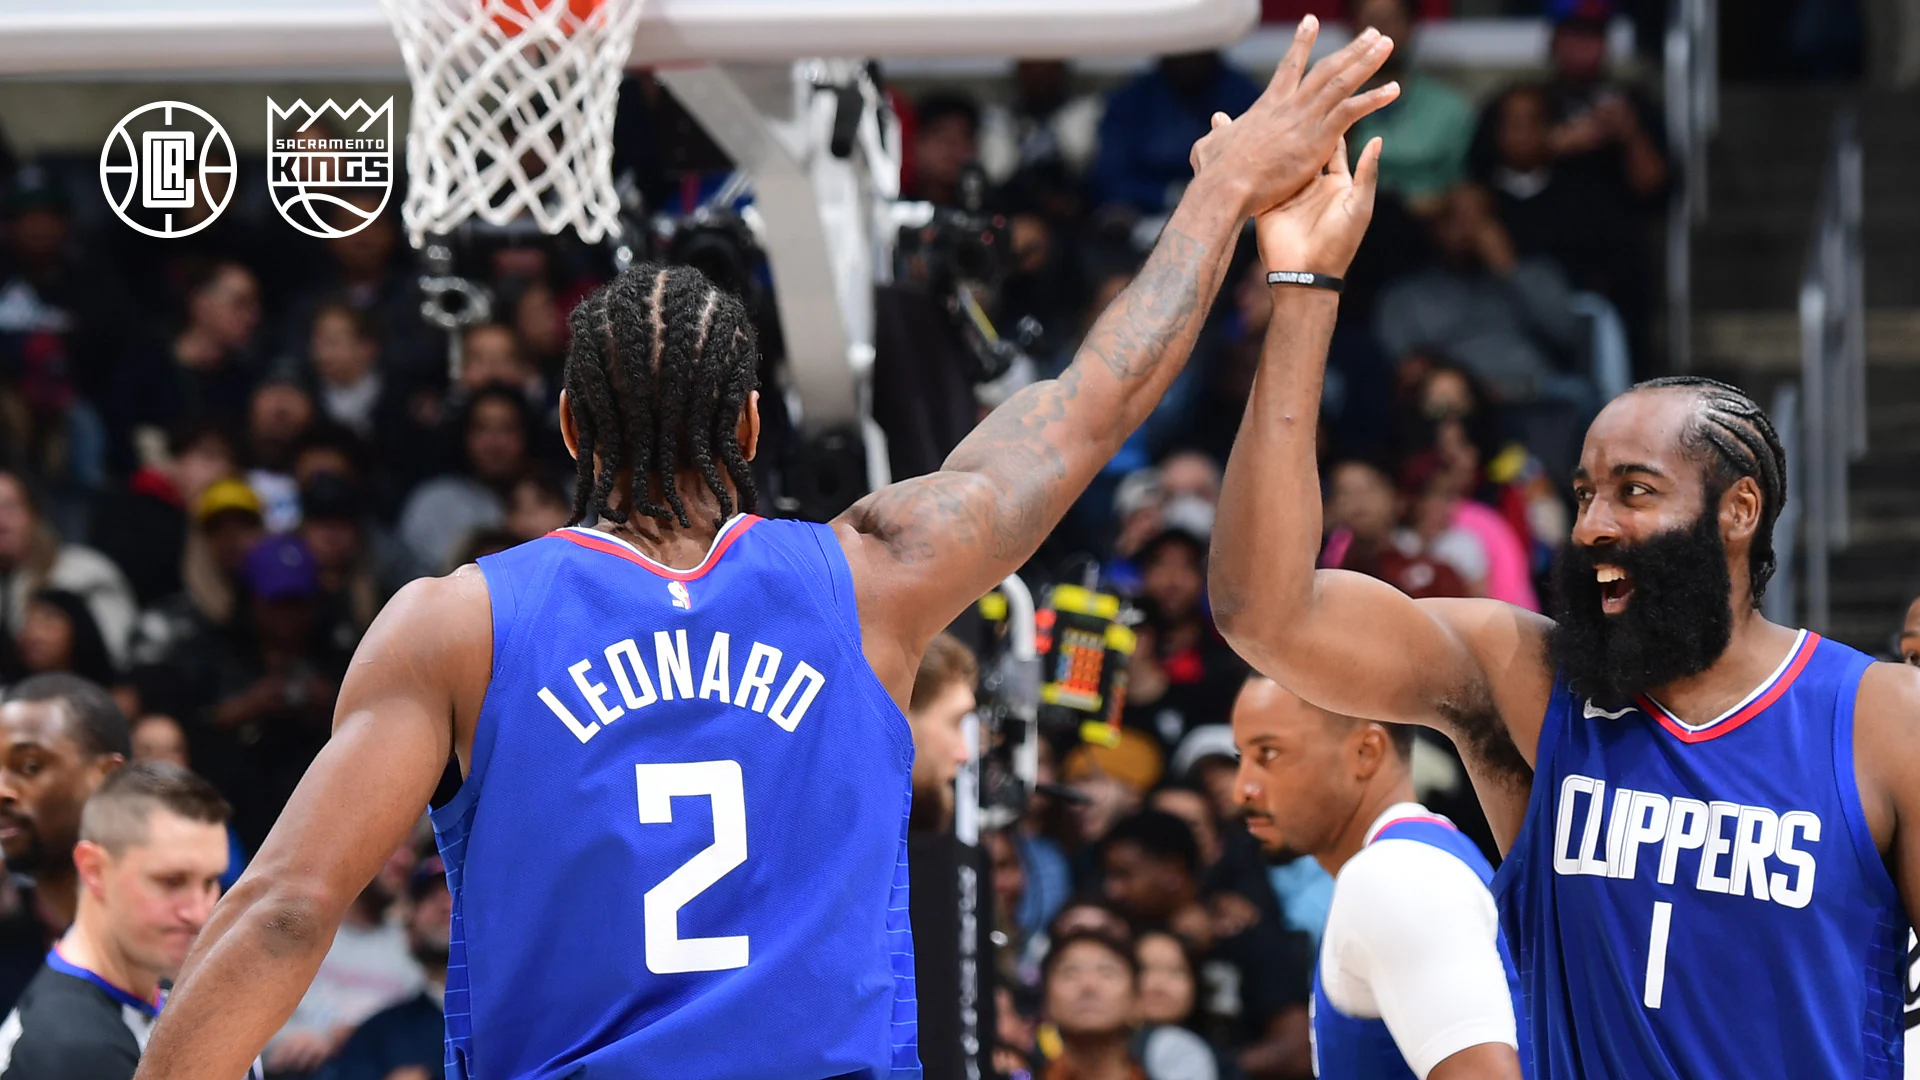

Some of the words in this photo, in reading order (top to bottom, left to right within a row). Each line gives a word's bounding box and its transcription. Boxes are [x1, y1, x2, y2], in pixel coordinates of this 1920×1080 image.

[537, 629, 826, 744] LEONARD
[635, 759, 749, 974] 2
[1554, 774, 1821, 908] CLIPPERS
[1644, 901, 1673, 1008] 1
